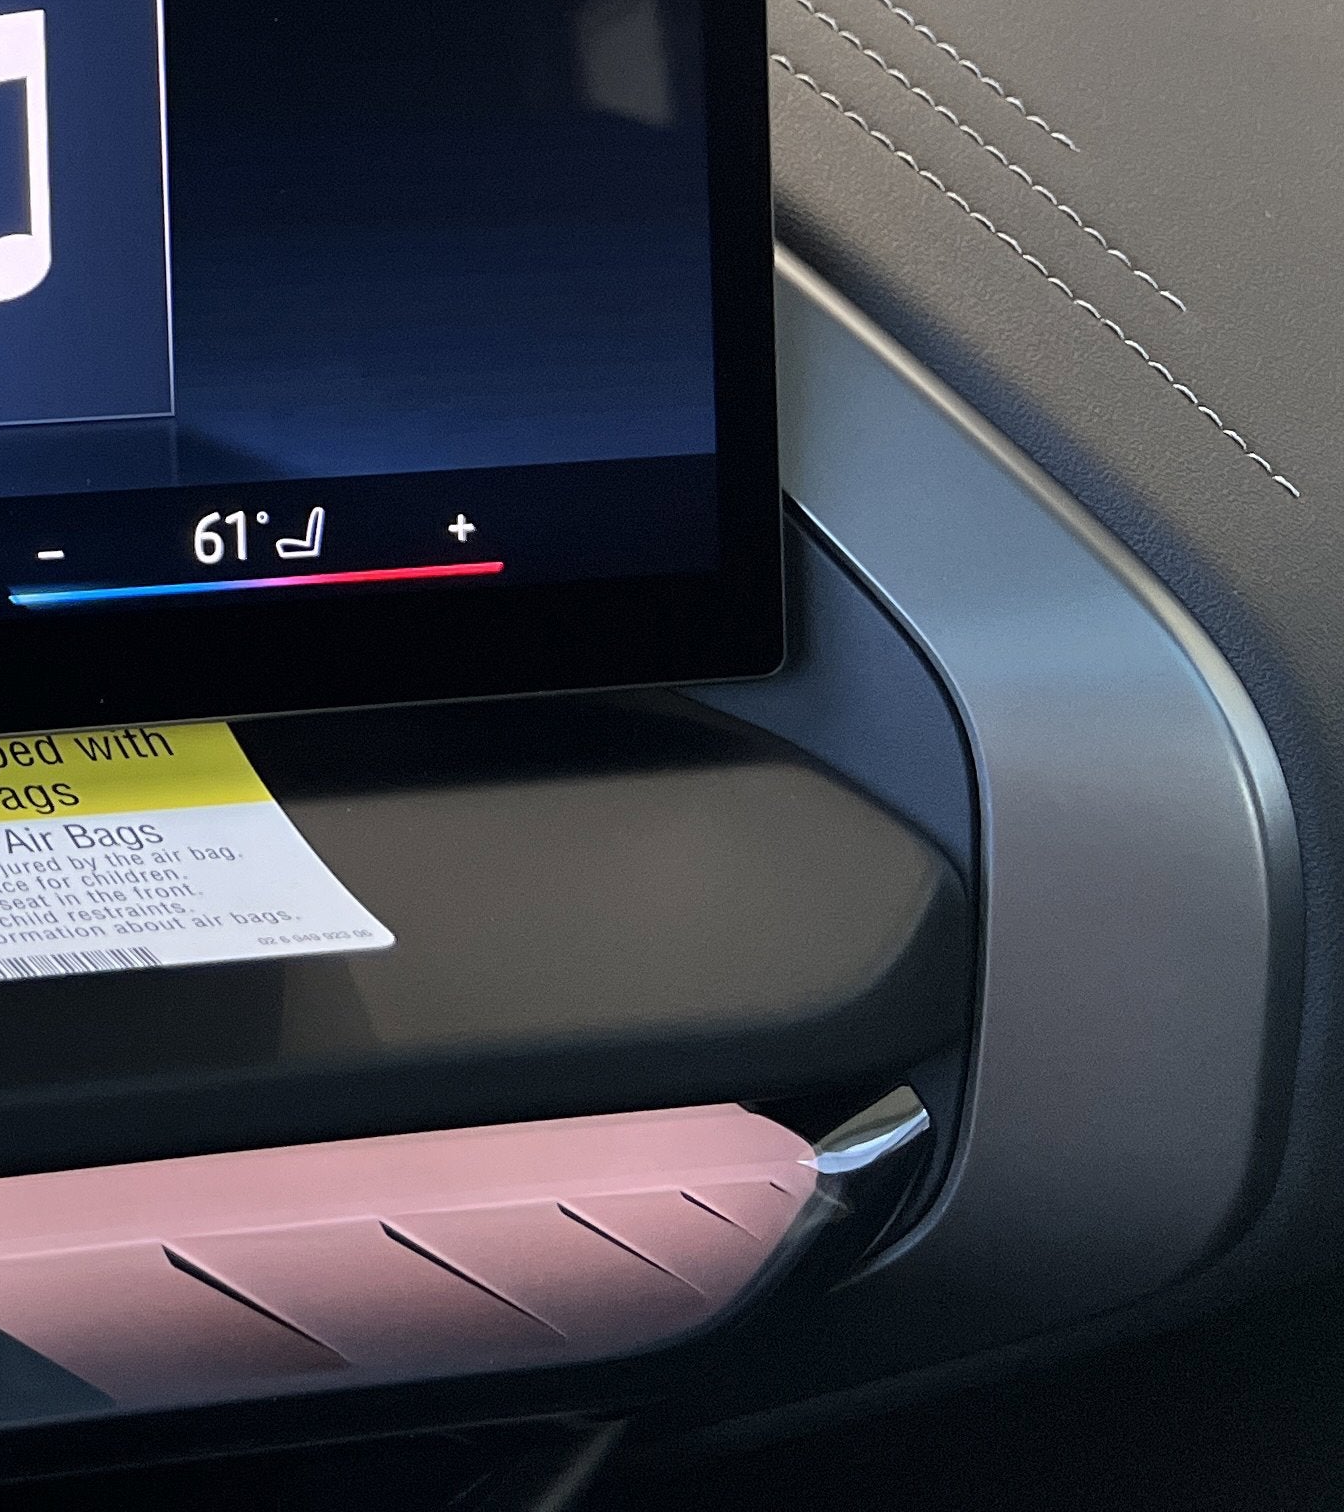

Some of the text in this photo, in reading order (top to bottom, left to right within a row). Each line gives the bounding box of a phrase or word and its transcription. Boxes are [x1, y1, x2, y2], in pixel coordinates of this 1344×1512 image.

[73, 728, 175, 762] with
[4, 827, 53, 855] Air
[63, 823, 164, 851] Bags
[68, 855, 97, 872] by
[105, 851, 144, 868] the
[151, 848, 182, 865] air
[188, 844, 243, 862] bag.
[37, 874, 71, 890] for
[81, 868, 189, 888] children.
[56, 891, 81, 907] in
[88, 888, 127, 905] the
[132, 881, 204, 902] front.
[67, 899, 195, 923] restraints.
[115, 915, 187, 935] about
[192, 911, 224, 929] air
[230, 907, 301, 926] bags.
